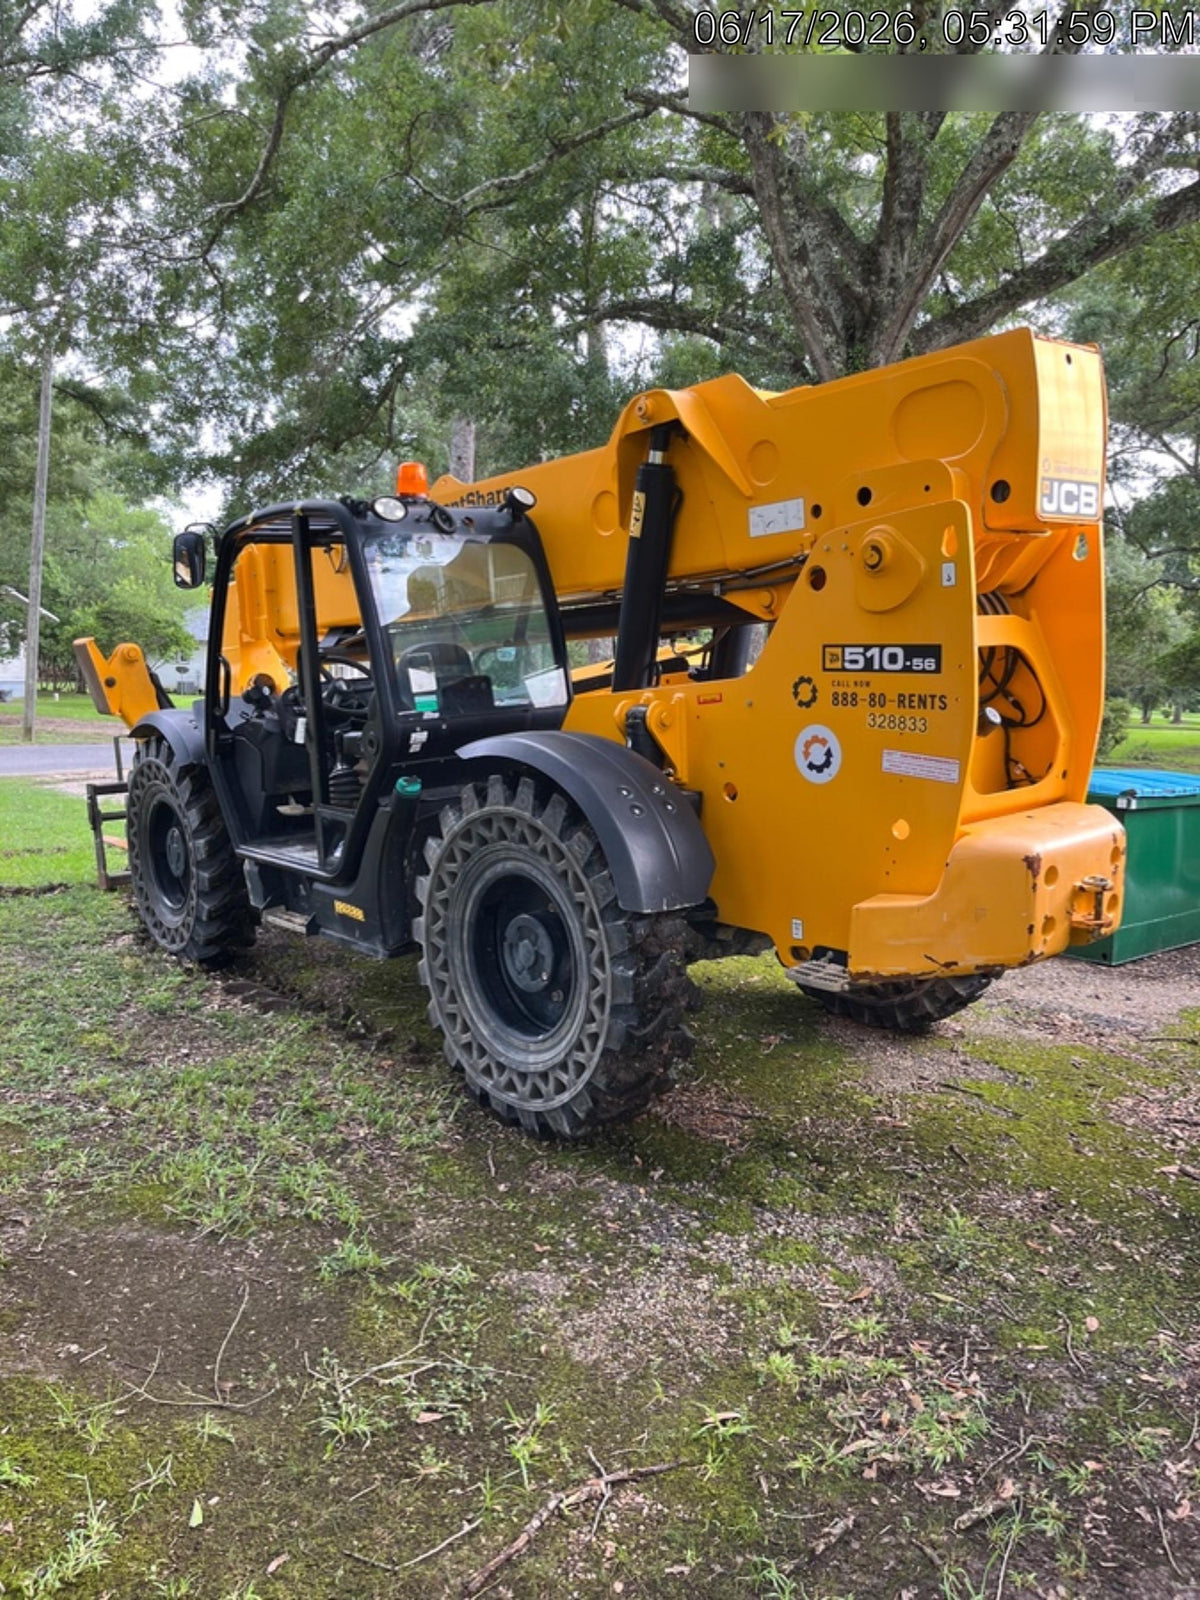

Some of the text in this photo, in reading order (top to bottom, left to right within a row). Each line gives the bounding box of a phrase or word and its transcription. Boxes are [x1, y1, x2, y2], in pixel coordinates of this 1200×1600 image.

[1042, 480, 1099, 515] JCB
[831, 680, 871, 688] CALL NOW
[831, 691, 948, 711] 888-80-RENTS
[868, 713, 928, 733] 328833
